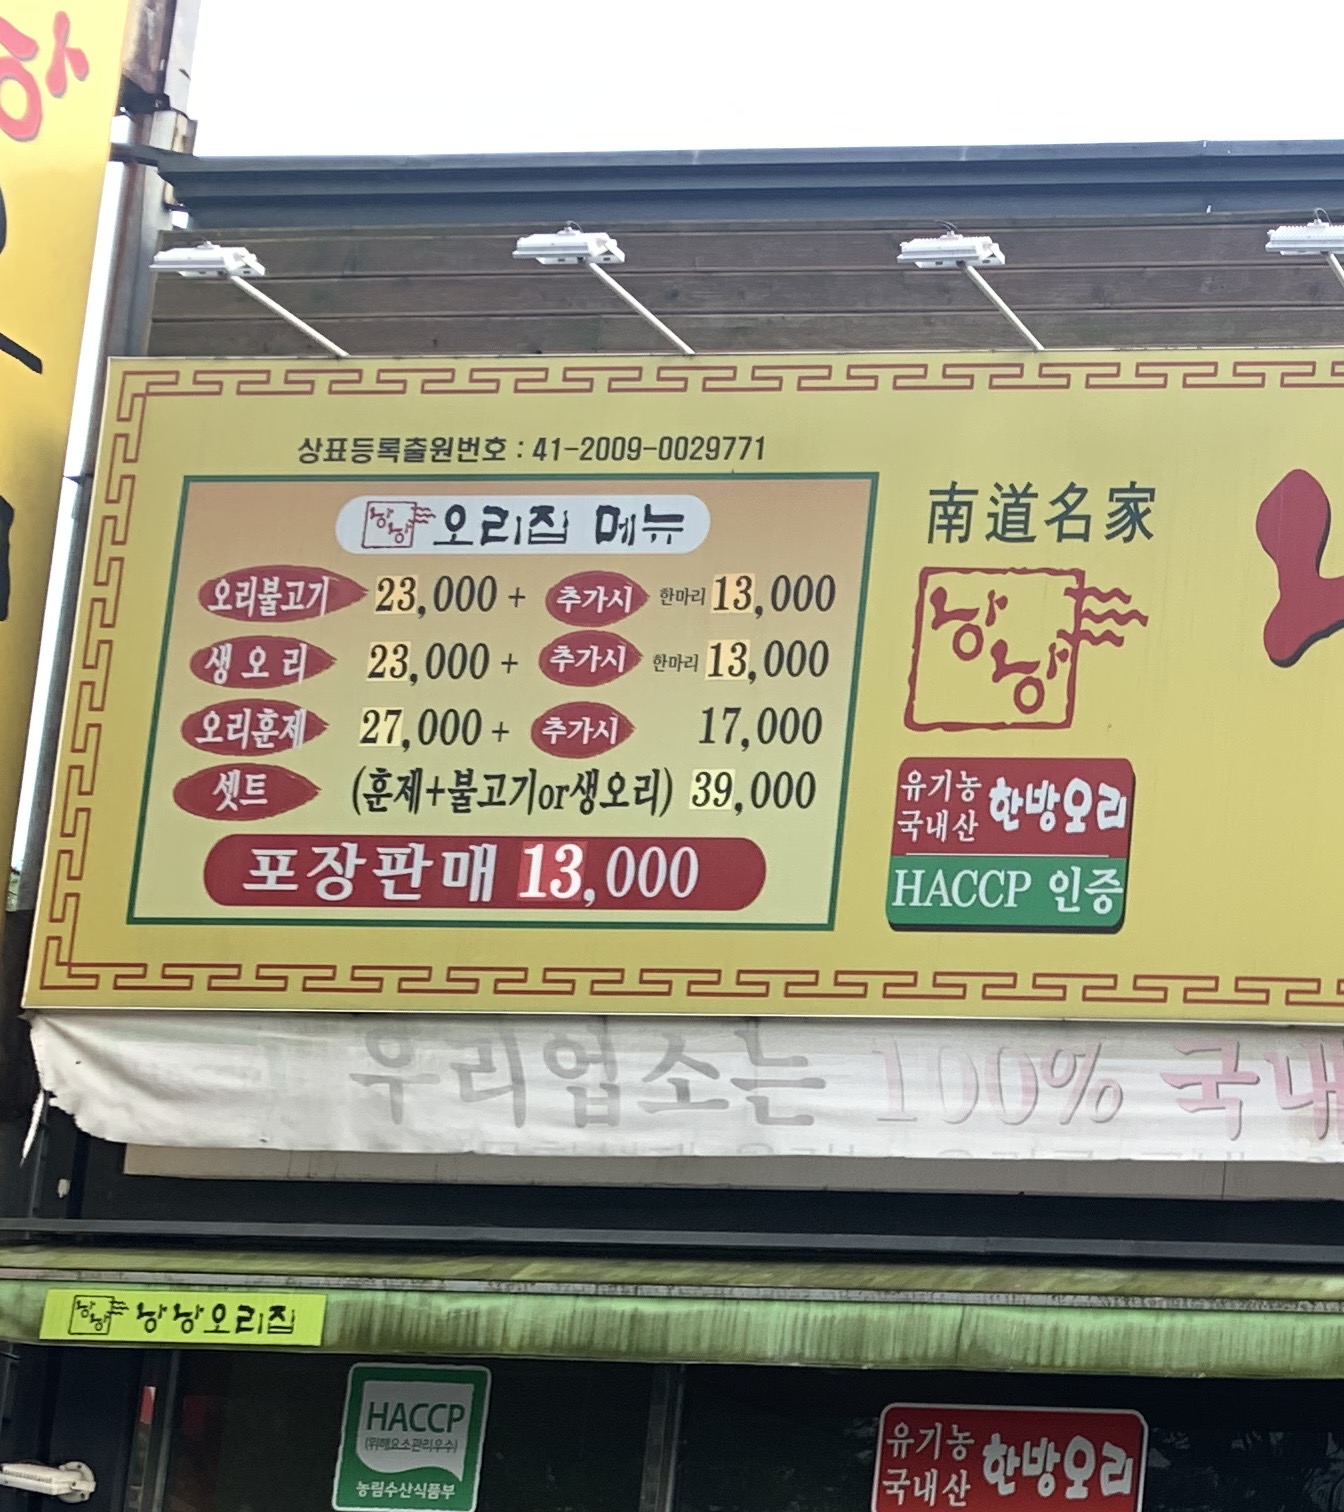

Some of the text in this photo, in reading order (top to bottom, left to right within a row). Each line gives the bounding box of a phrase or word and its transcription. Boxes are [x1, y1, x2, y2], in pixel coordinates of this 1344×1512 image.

[299, 435, 765, 464] 상표등록출원번호 41-2009-0029771
[432, 504, 568, 547] 오리집
[596, 503, 684, 546] 메뉴
[928, 480, 1156, 544] 南道名家
[209, 575, 835, 618] 오리불고기 23,000 추가시 한마리 13,000
[367, 642, 489, 687] 23,000
[550, 646, 626, 675] 추가시
[653, 653, 698, 673] 한마리
[706, 641, 830, 684] 13,000
[195, 706, 821, 752] 오리훈제 27,000 추가시 17,000
[212, 773, 269, 812] 셋트
[692, 770, 816, 815] 39,000
[901, 770, 982, 802] 유기농
[989, 778, 1127, 833] 한방오리
[897, 809, 978, 843] 국내산
[243, 843, 698, 905] 포장판매 13,000
[892, 865, 1122, 915] HACCP 인증
[349, 1018, 825, 1128] 우리업소는
[873, 1042, 1124, 1125] 100%
[367, 1402, 465, 1434] HACCP
[886, 1422, 975, 1462] 유기농
[882, 1469, 971, 1508] 국내산
[982, 1433, 1133, 1500] 한방오리
[356, 1480, 455, 1500] 농림수산식품부
